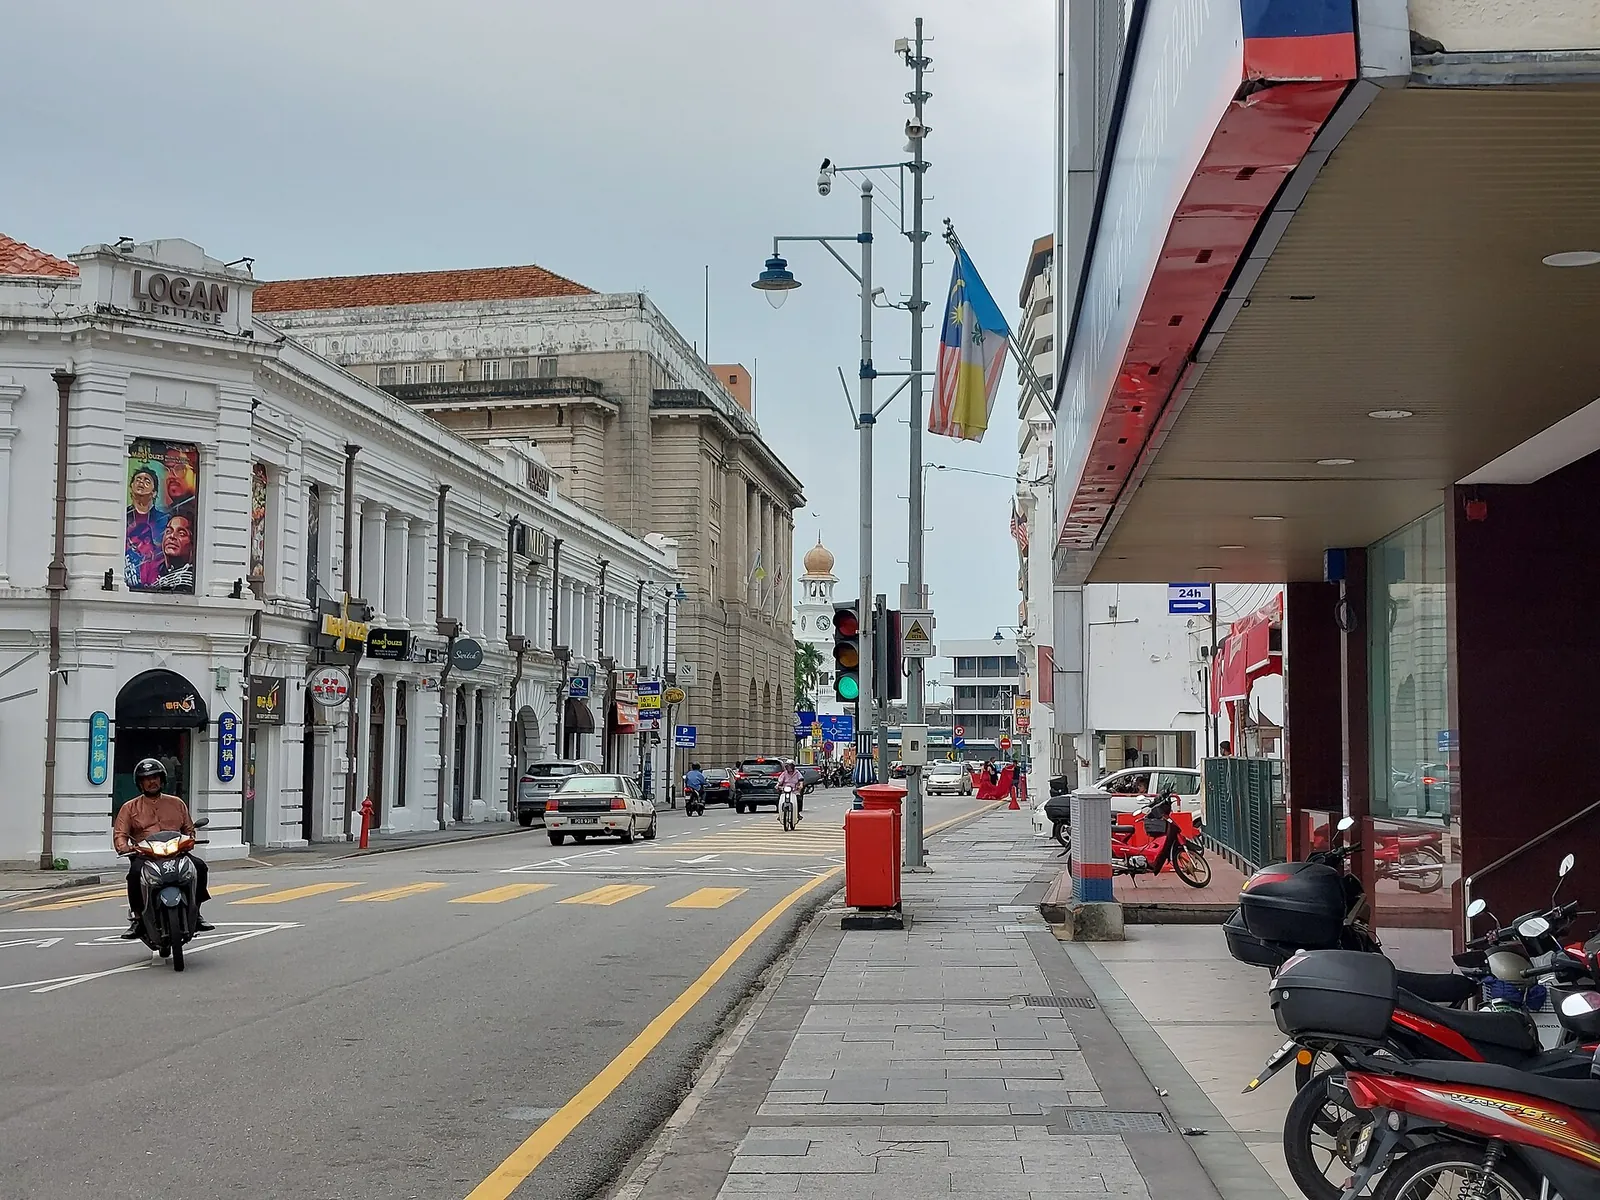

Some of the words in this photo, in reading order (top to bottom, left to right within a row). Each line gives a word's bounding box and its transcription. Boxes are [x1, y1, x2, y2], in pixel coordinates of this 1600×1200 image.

[133, 269, 229, 312] LOGAN
[139, 300, 222, 324] HERITAGE
[1179, 589, 1201, 598] 24h
[453, 650, 480, 660] Switch
[1450, 1093, 1518, 1113] WAVE
